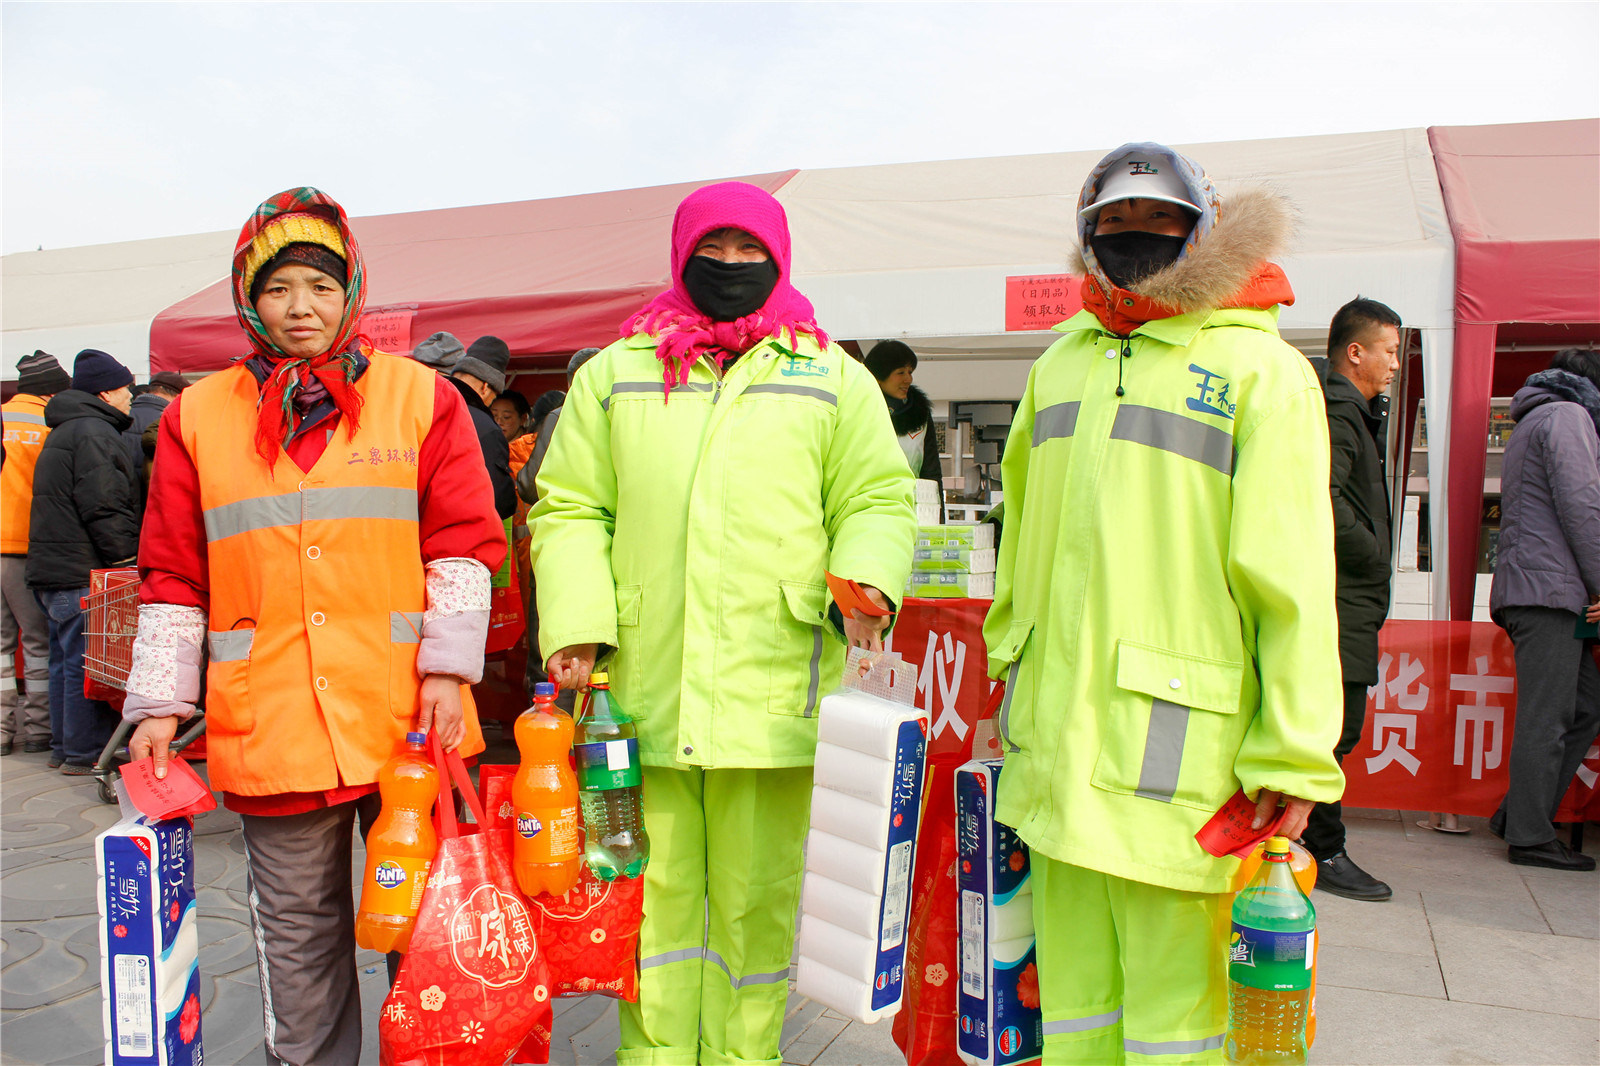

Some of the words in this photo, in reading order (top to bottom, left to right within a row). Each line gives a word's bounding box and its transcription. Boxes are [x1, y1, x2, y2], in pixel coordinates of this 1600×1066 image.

[1024, 304, 1067, 317] 领取处
[347, 446, 417, 467] 二泉环境
[517, 818, 542, 831] FANTA
[136, 838, 149, 851] NEW
[375, 867, 406, 881] FANTA
